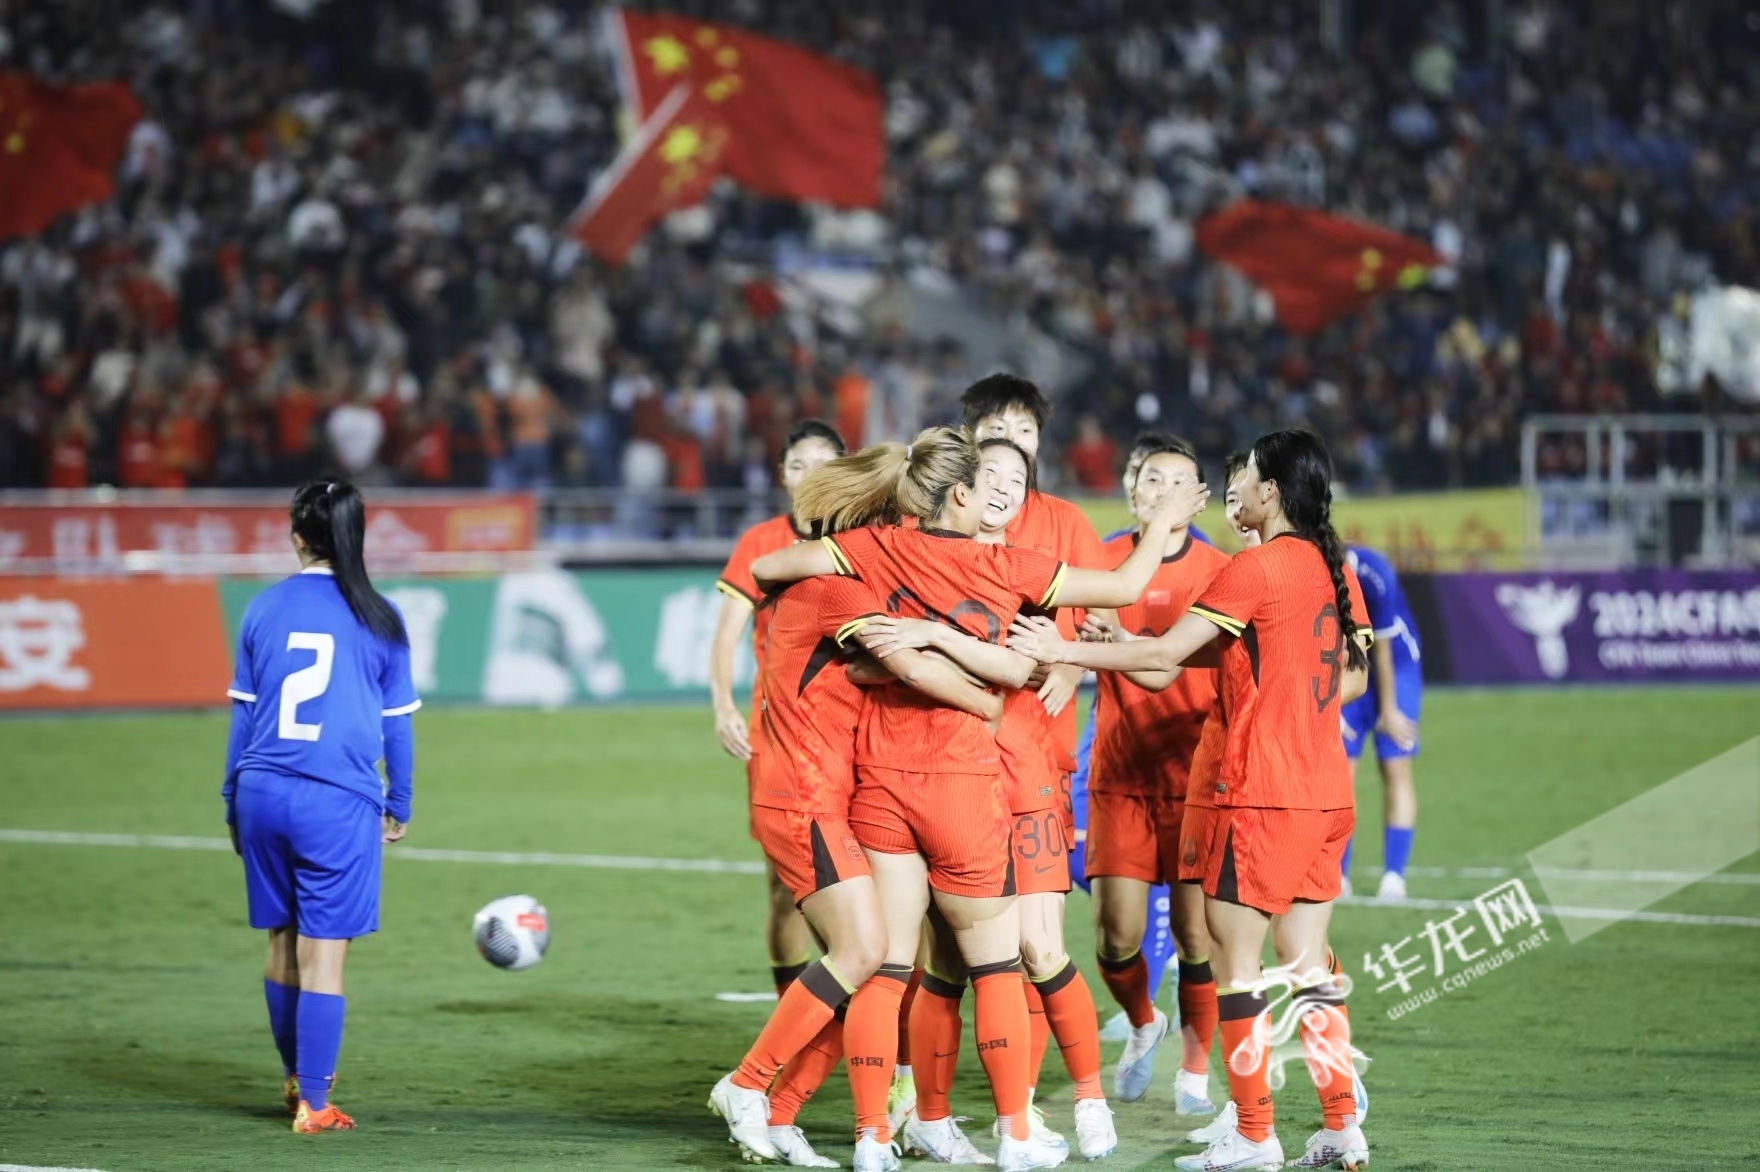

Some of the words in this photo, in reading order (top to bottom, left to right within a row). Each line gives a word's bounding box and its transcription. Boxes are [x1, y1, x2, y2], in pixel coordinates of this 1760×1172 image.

[279, 632, 334, 742] 2
[1015, 812, 1062, 859] 30
[851, 1056, 884, 1067] 中国
